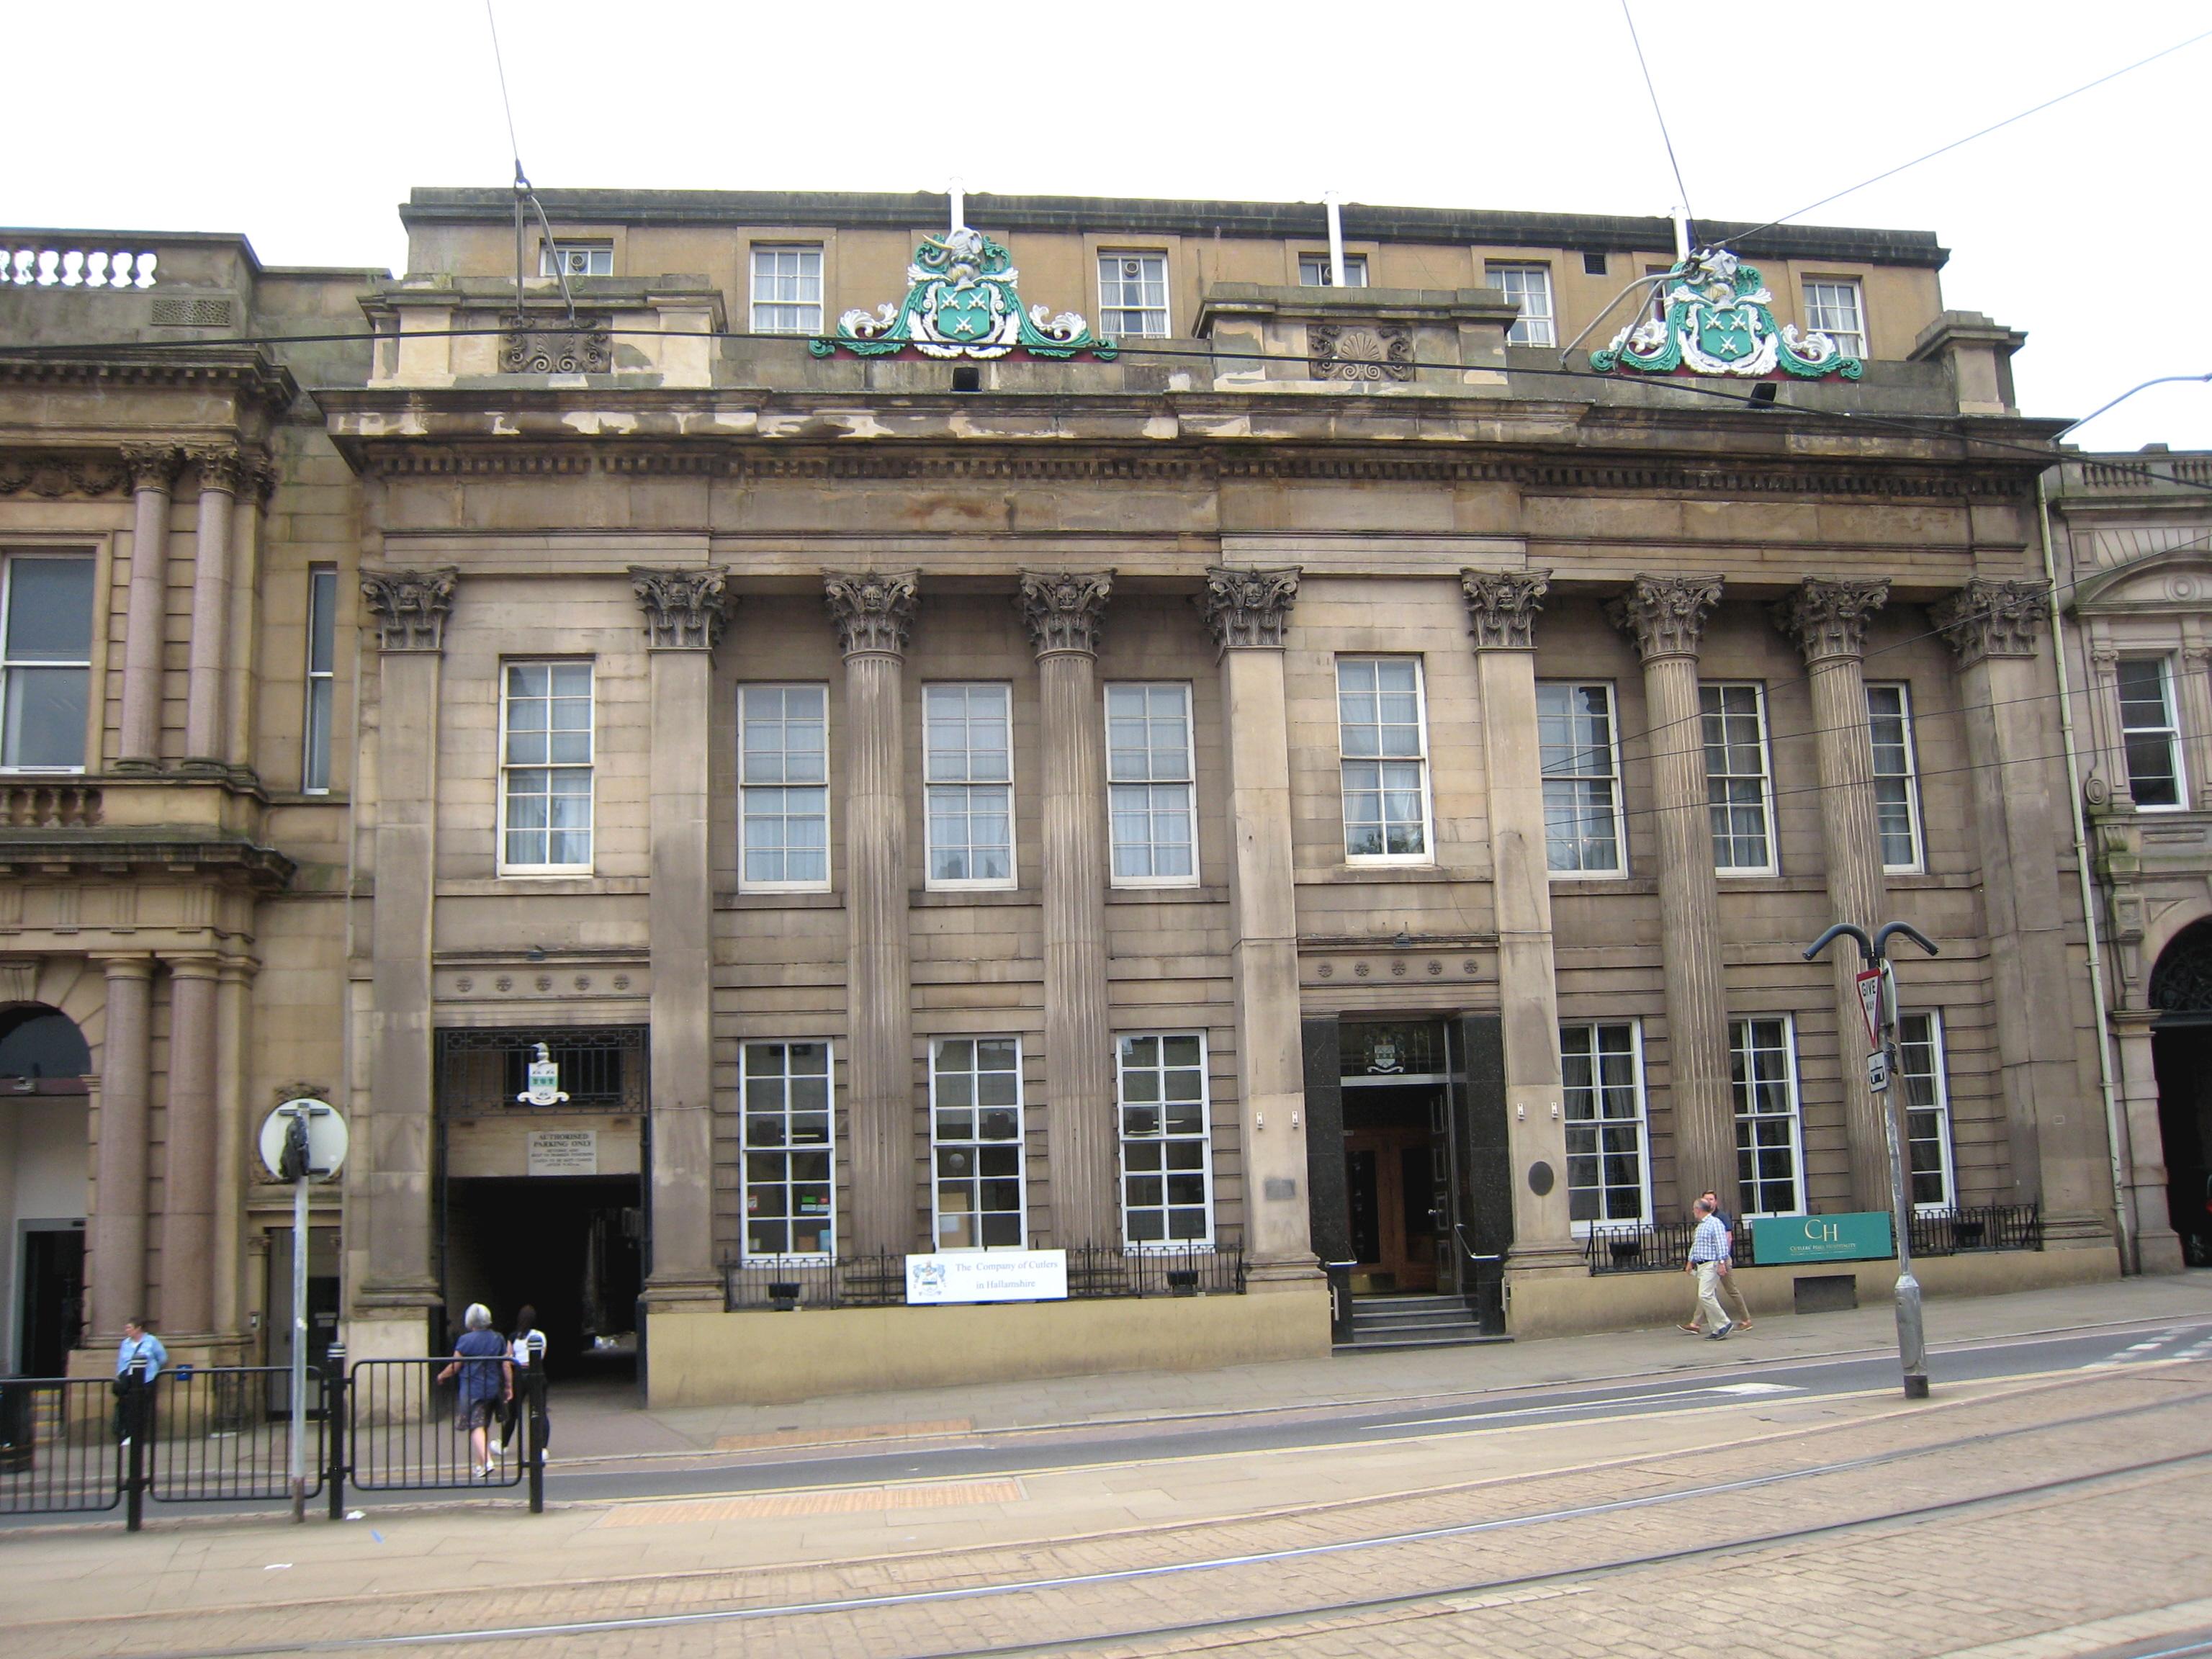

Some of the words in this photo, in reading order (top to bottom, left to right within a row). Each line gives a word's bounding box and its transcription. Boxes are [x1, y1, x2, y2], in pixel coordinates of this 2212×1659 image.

[1861, 980, 1876, 997] GIVE
[1804, 1219, 1838, 1241] CH
[956, 1263, 971, 1272] The
[976, 1262, 1015, 1273] Company
[1018, 1261, 1028, 1269] of
[1029, 1260, 1058, 1269] Cutlers
[986, 1280, 1035, 1289] Hallamshire
